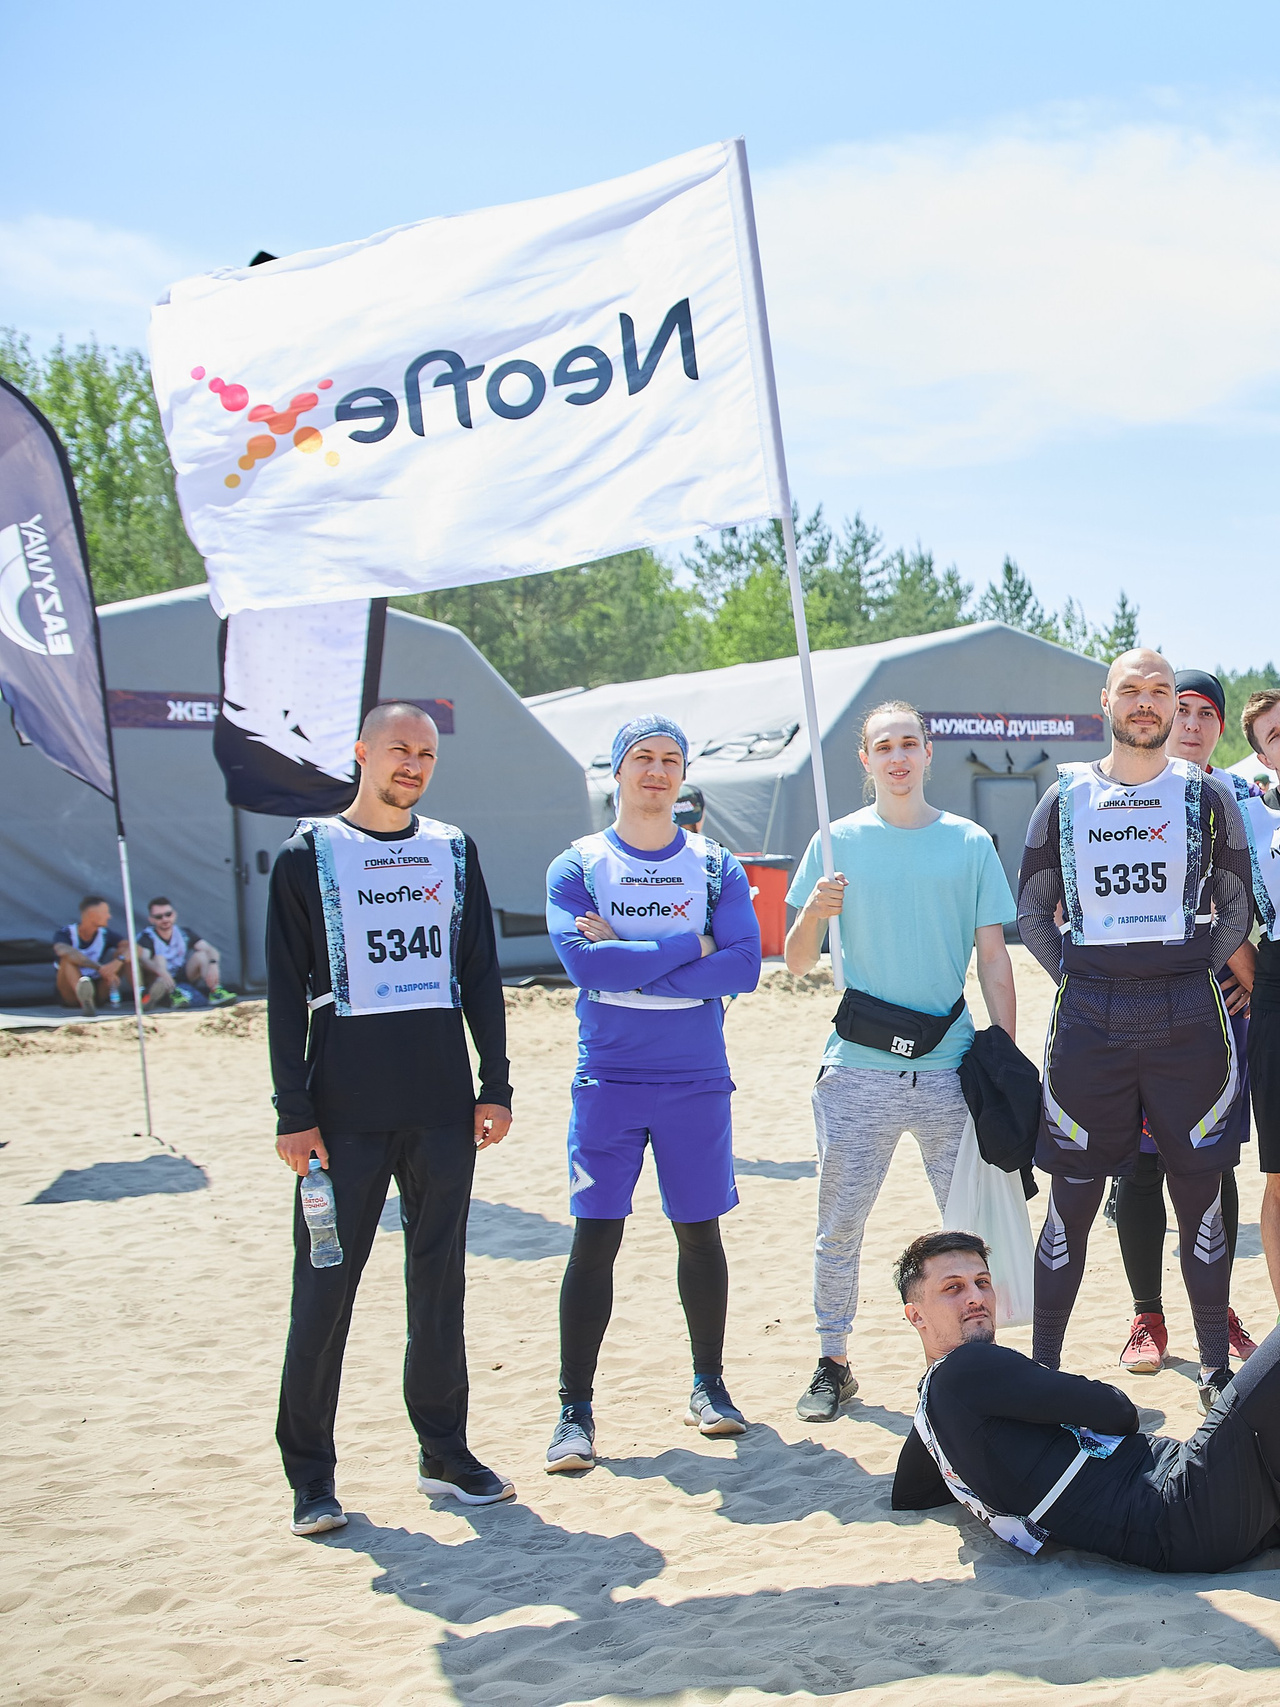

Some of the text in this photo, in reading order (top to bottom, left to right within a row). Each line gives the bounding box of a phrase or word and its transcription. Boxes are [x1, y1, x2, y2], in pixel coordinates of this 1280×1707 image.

[930, 717, 1075, 737] МУЖСКАЯ ДУШЕВАЯ
[1098, 798, 1161, 808] ГОНКА ГЕРОЕВ
[1088, 820, 1171, 844] Neoflex
[364, 856, 430, 867] ГОНКА ГЕРОЕВ
[620, 876, 683, 884] ГОНКА ГЕРОЕВ
[1094, 862, 1168, 898] 5335
[357, 879, 443, 906] Neoflex
[611, 897, 694, 921] Neoflex
[1117, 914, 1167, 925] ГАЗПРОМБАНК
[366, 924, 442, 964] 5340
